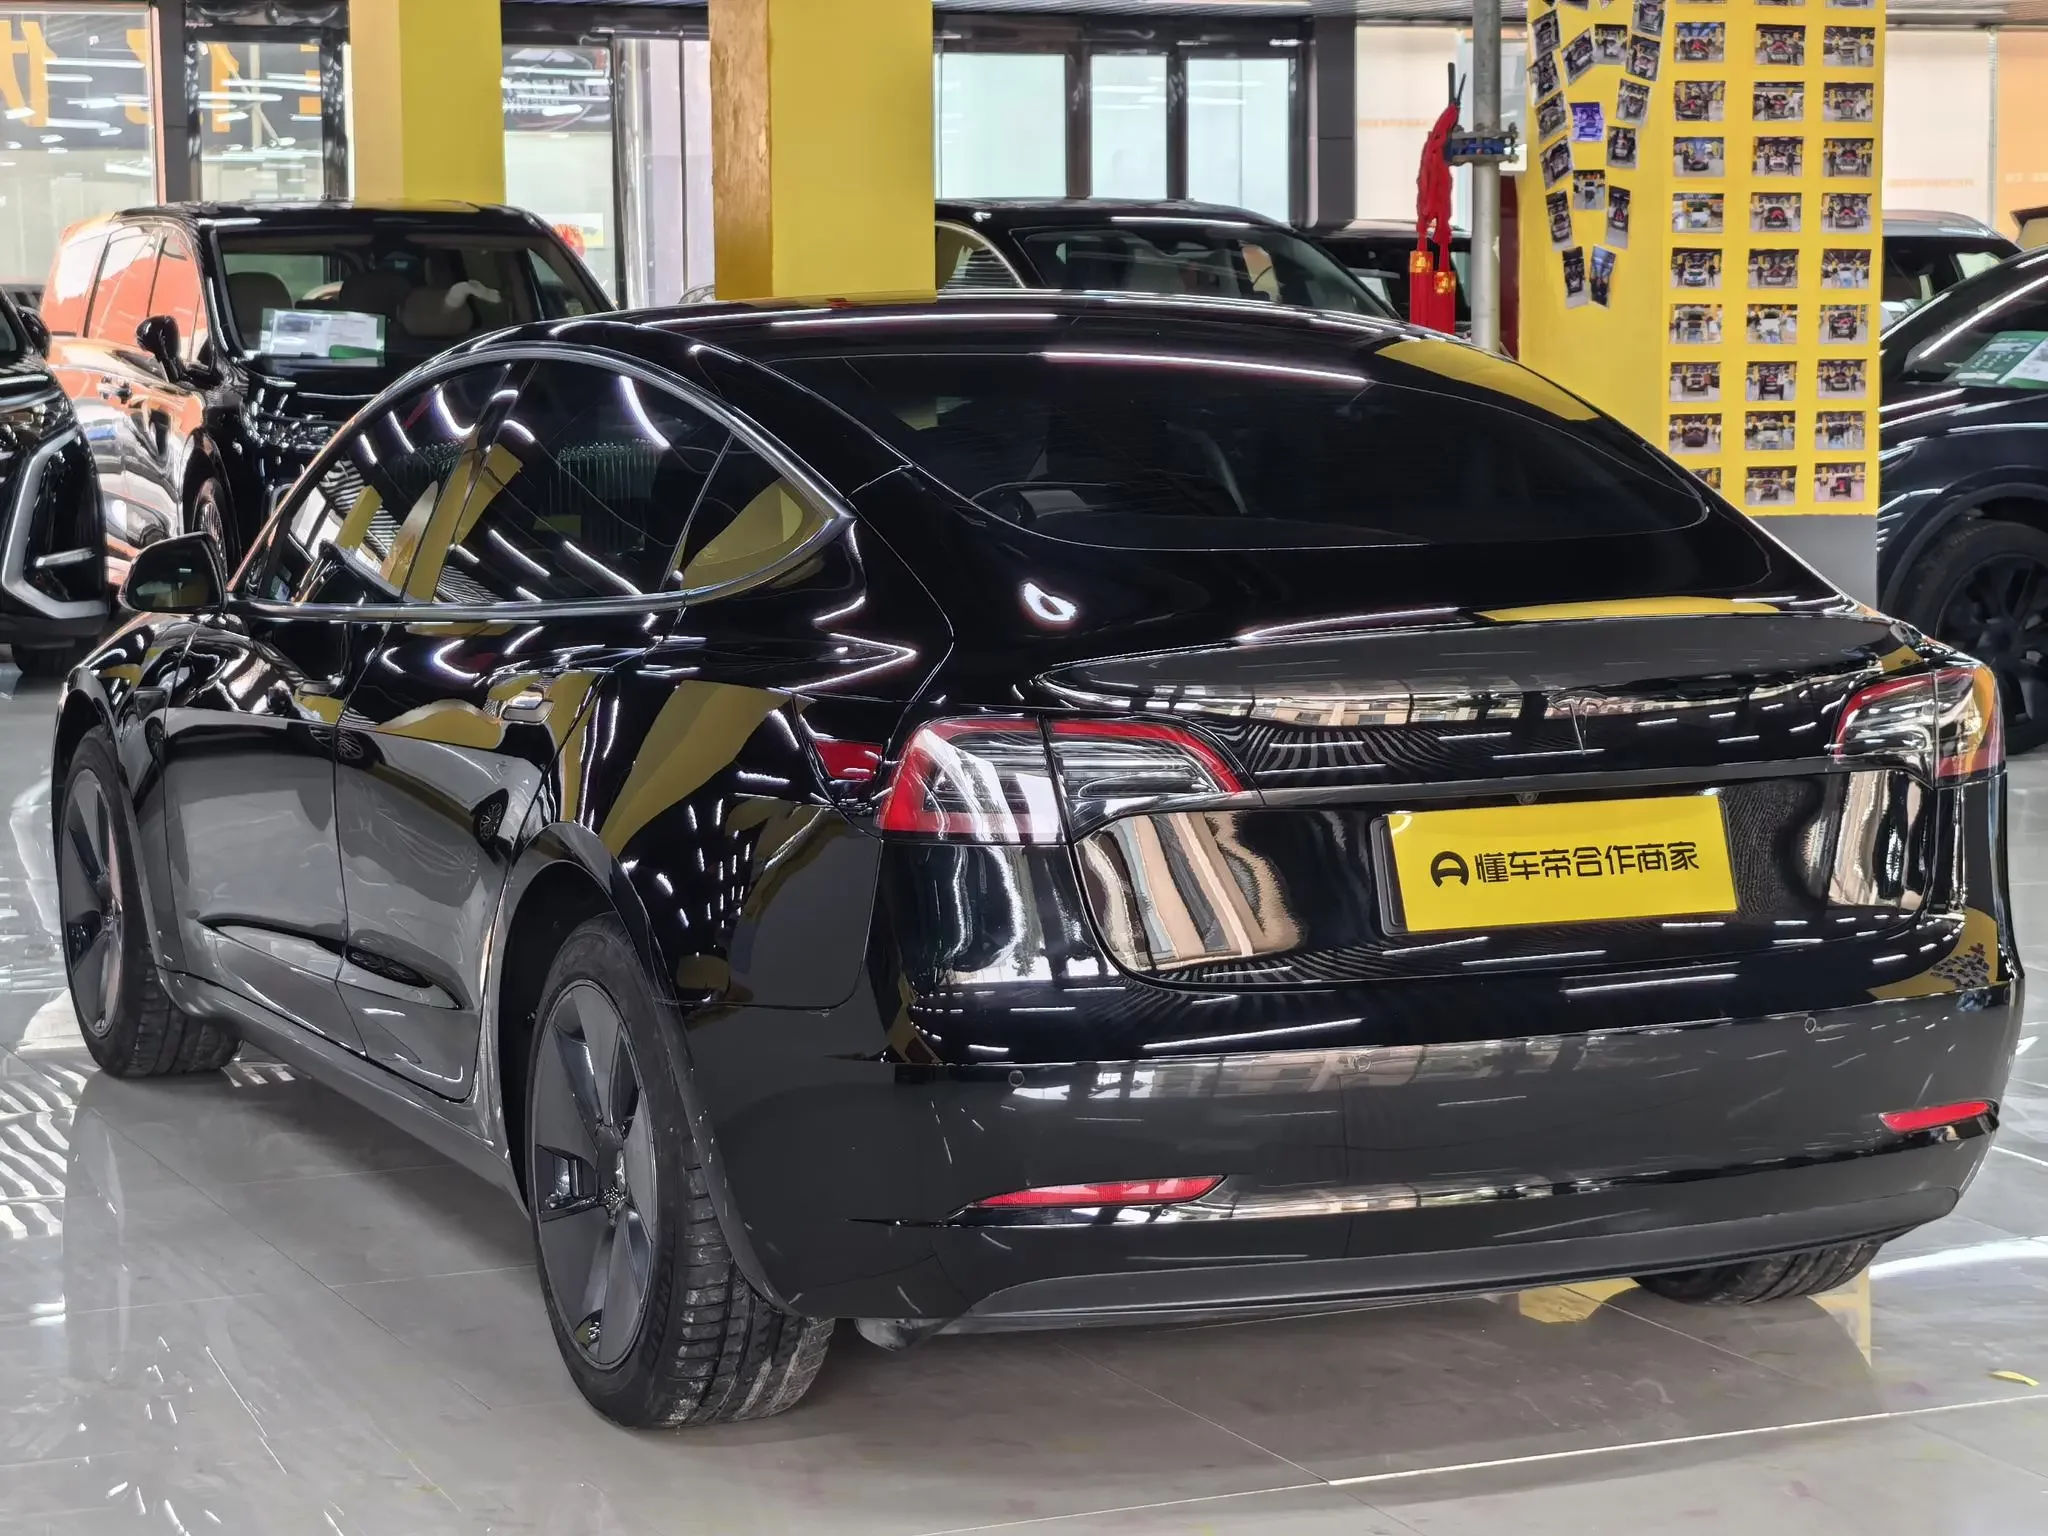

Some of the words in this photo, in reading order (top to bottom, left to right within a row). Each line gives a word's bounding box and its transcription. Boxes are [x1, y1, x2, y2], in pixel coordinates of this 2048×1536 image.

[1475, 841, 1700, 883] 懂车帝合作商家
